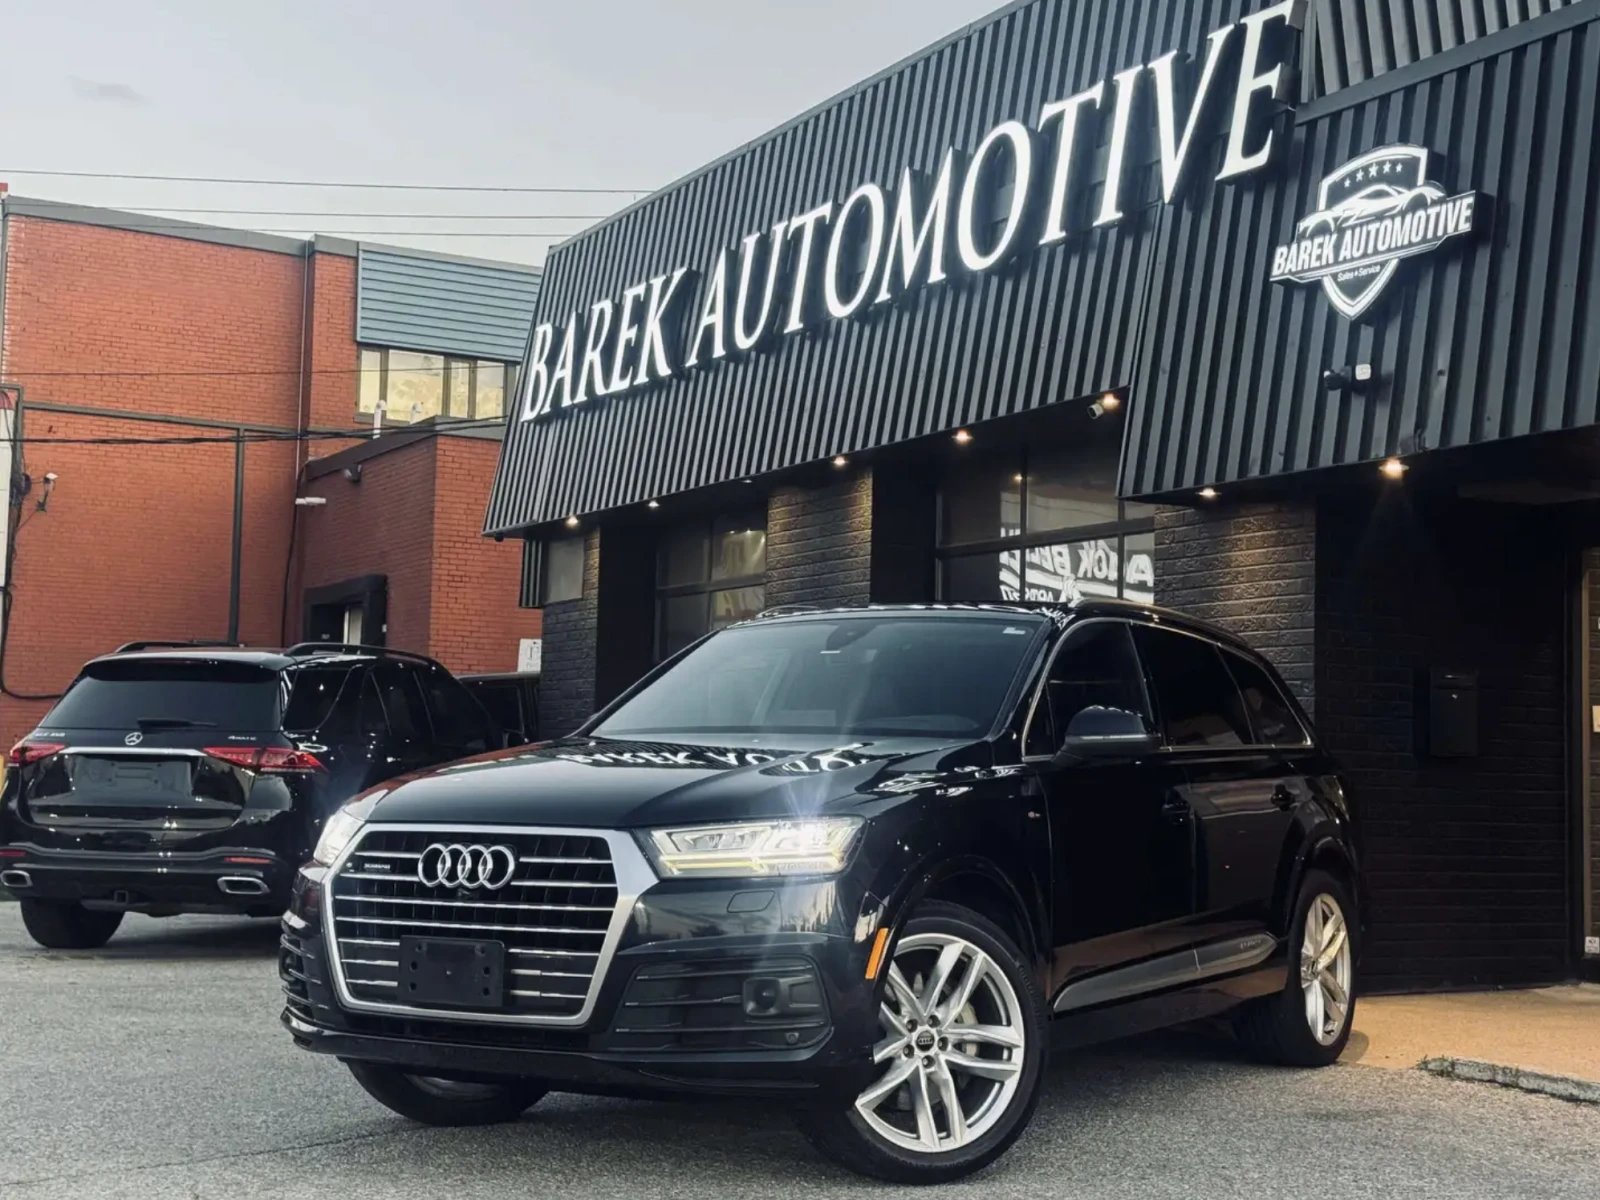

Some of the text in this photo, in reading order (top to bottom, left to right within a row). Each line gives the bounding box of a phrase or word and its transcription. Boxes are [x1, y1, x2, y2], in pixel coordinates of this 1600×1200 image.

[521, 0, 1295, 422] BAREK AUTOMOTIVE
[1273, 198, 1473, 275] BAREK AUTOMOTIVE
